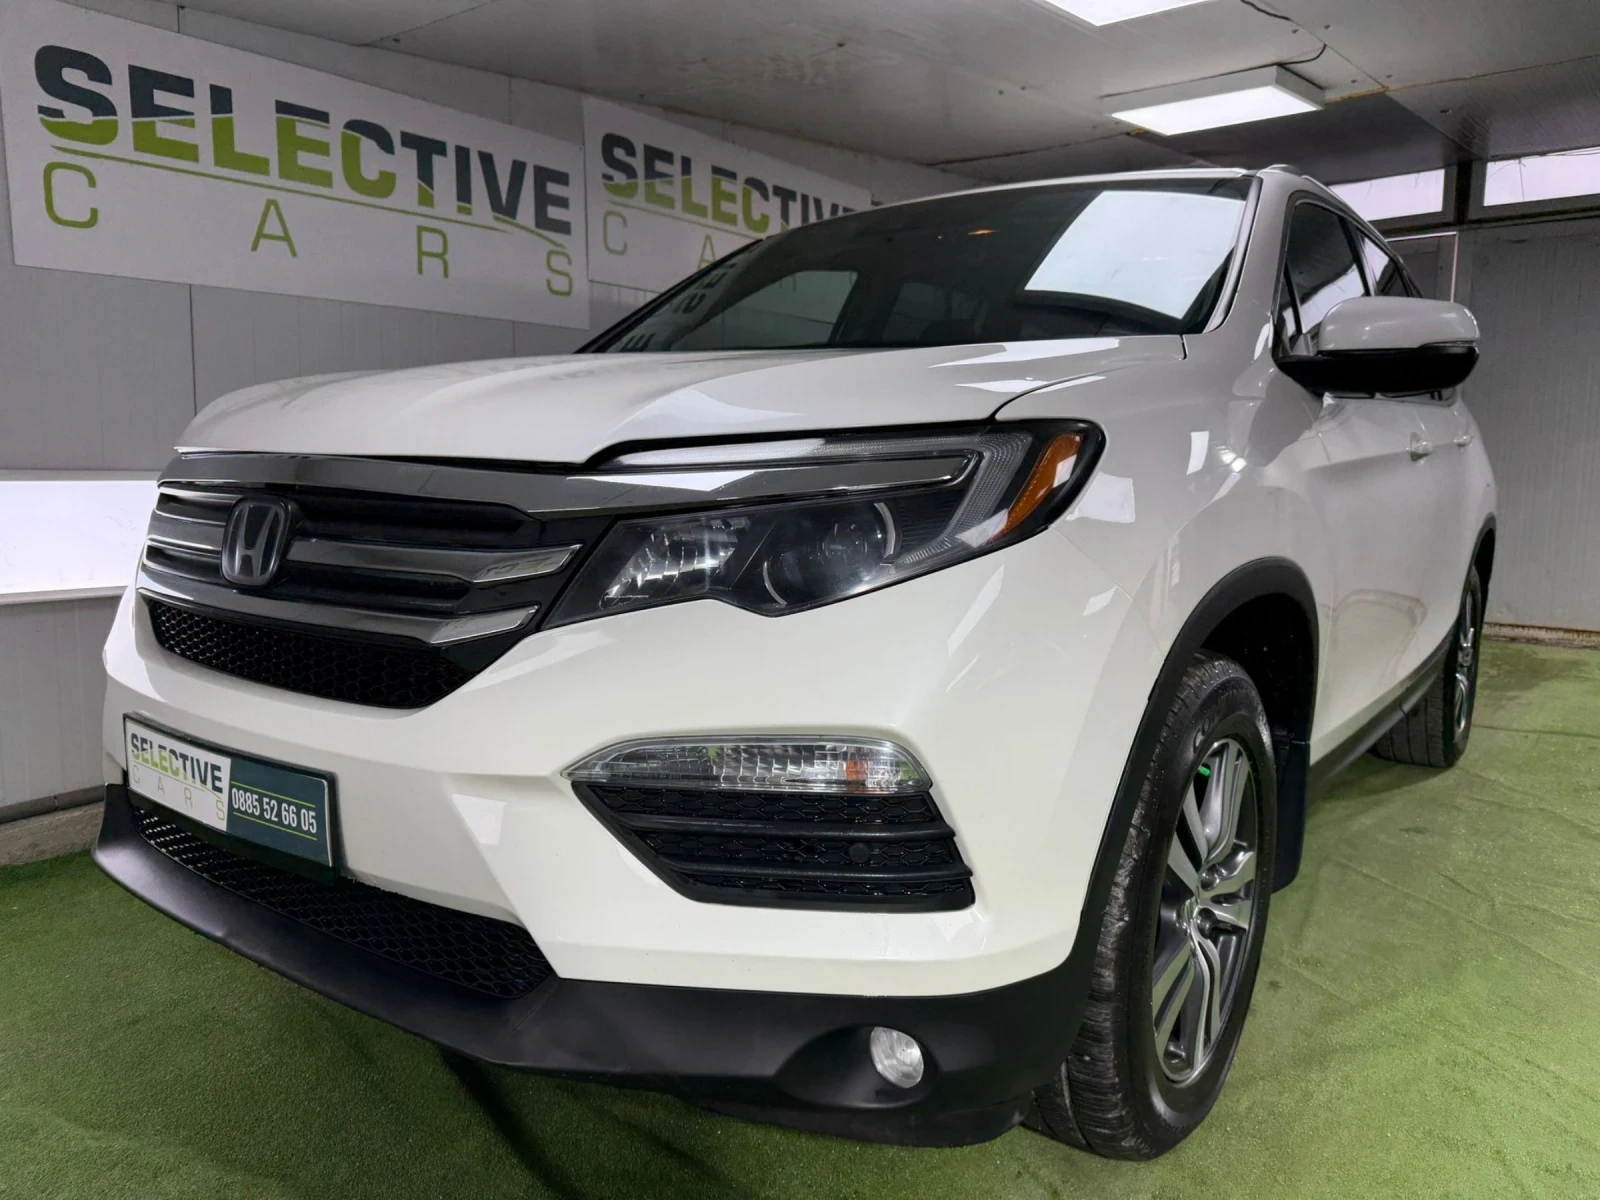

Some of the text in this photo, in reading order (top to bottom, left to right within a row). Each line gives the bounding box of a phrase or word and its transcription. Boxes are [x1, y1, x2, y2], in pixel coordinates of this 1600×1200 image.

[34, 45, 572, 236] SELECTIVE
[601, 132, 856, 235] SELECTIV
[43, 161, 573, 297] CARS
[131, 733, 223, 793] SELECTIVE
[231, 788, 317, 834] 0885 52 66 05
